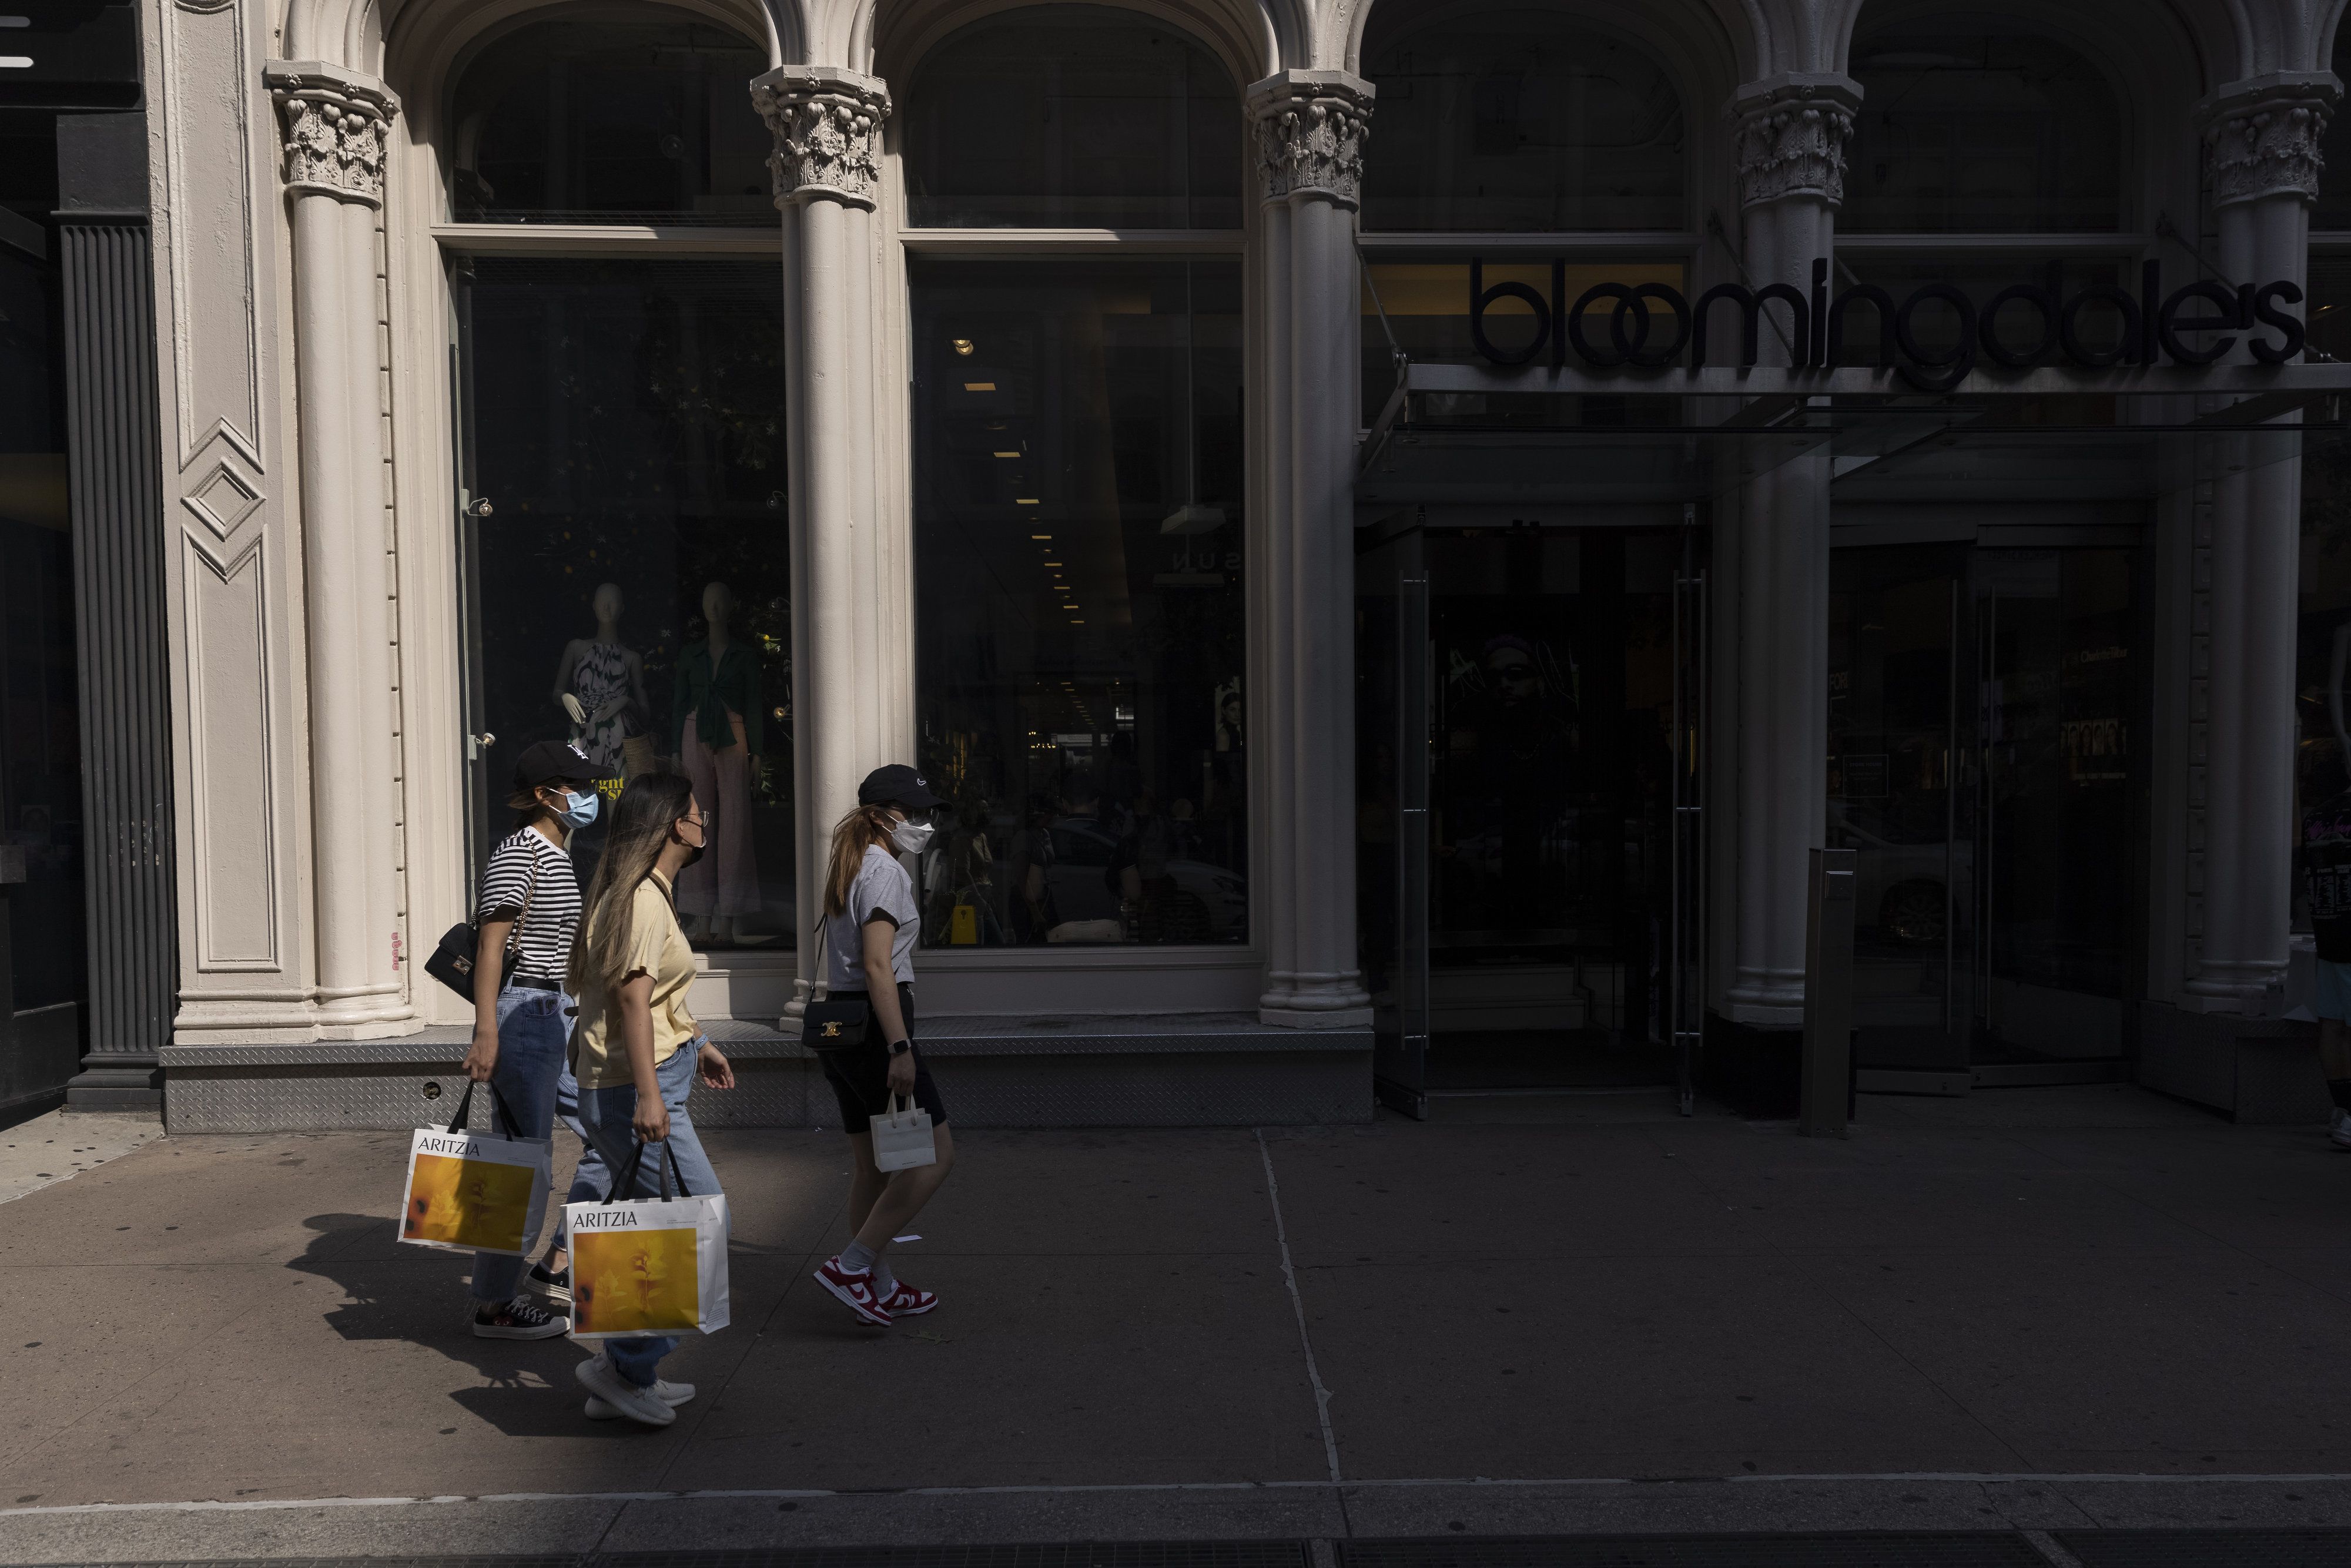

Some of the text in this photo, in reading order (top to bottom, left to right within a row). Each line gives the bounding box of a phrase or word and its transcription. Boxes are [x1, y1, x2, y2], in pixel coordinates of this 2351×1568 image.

[1471, 257, 2306, 392] bloomingdale's
[418, 1137, 480, 1156] ARITZIA
[573, 1211, 638, 1228] ARITZIA
